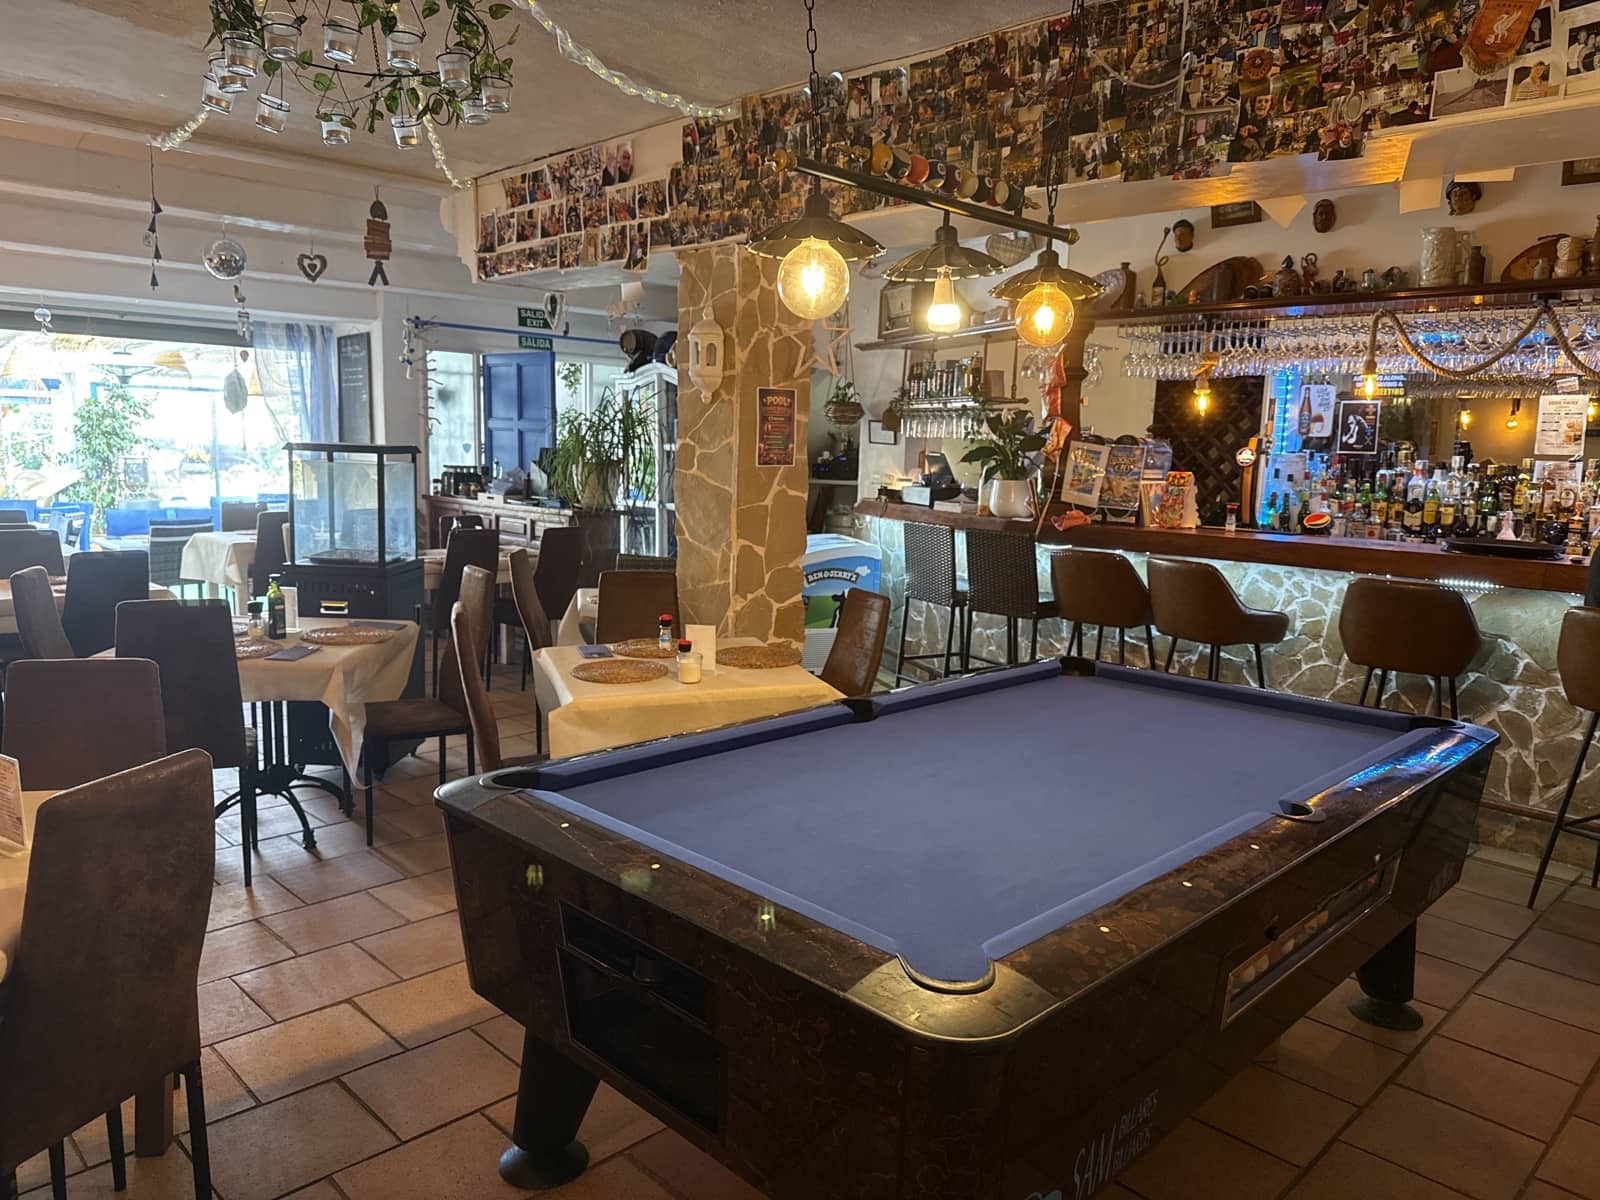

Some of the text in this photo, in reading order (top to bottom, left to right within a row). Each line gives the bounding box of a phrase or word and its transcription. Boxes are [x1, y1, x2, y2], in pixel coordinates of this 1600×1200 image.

[520, 309, 545, 319] SALID
[527, 319, 544, 327] EXIT
[521, 337, 551, 349] SALIDA
[766, 396, 789, 406] POOL
[807, 573, 823, 582] BEN
[829, 570, 857, 581] JERRY'S
